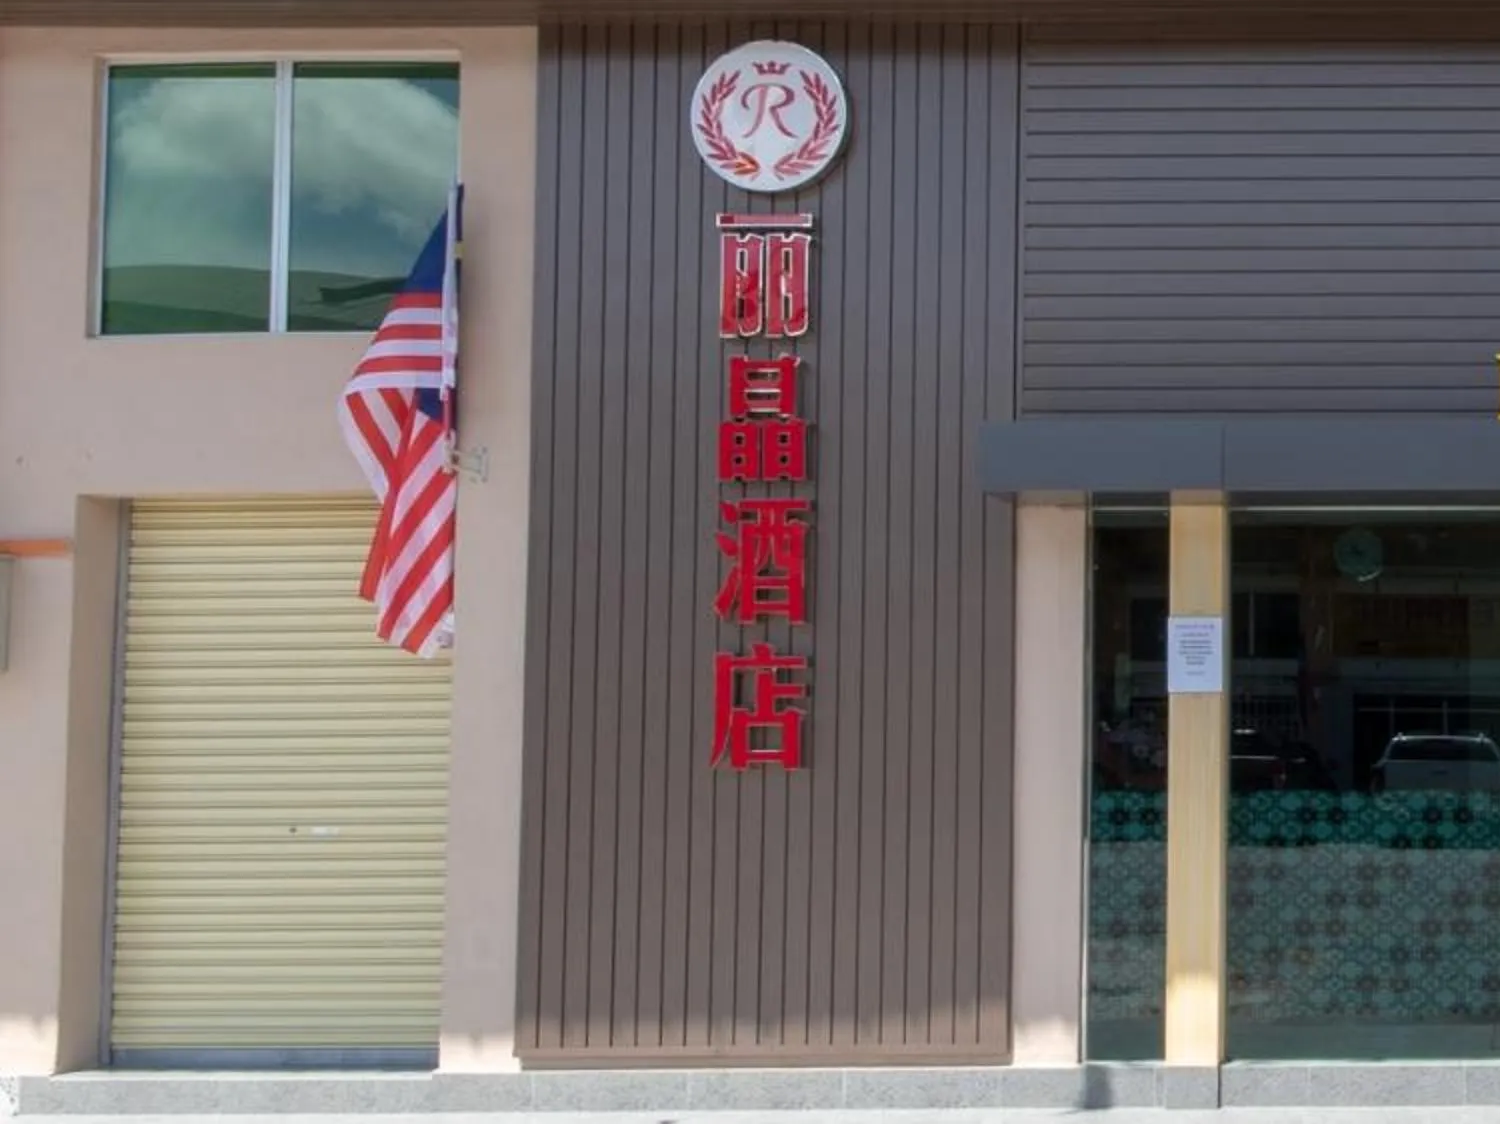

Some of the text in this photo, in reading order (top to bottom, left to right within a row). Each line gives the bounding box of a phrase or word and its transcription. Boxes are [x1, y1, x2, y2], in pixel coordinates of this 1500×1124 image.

[740, 82, 798, 140] R
[711, 213, 813, 771] 丽晶酒店
